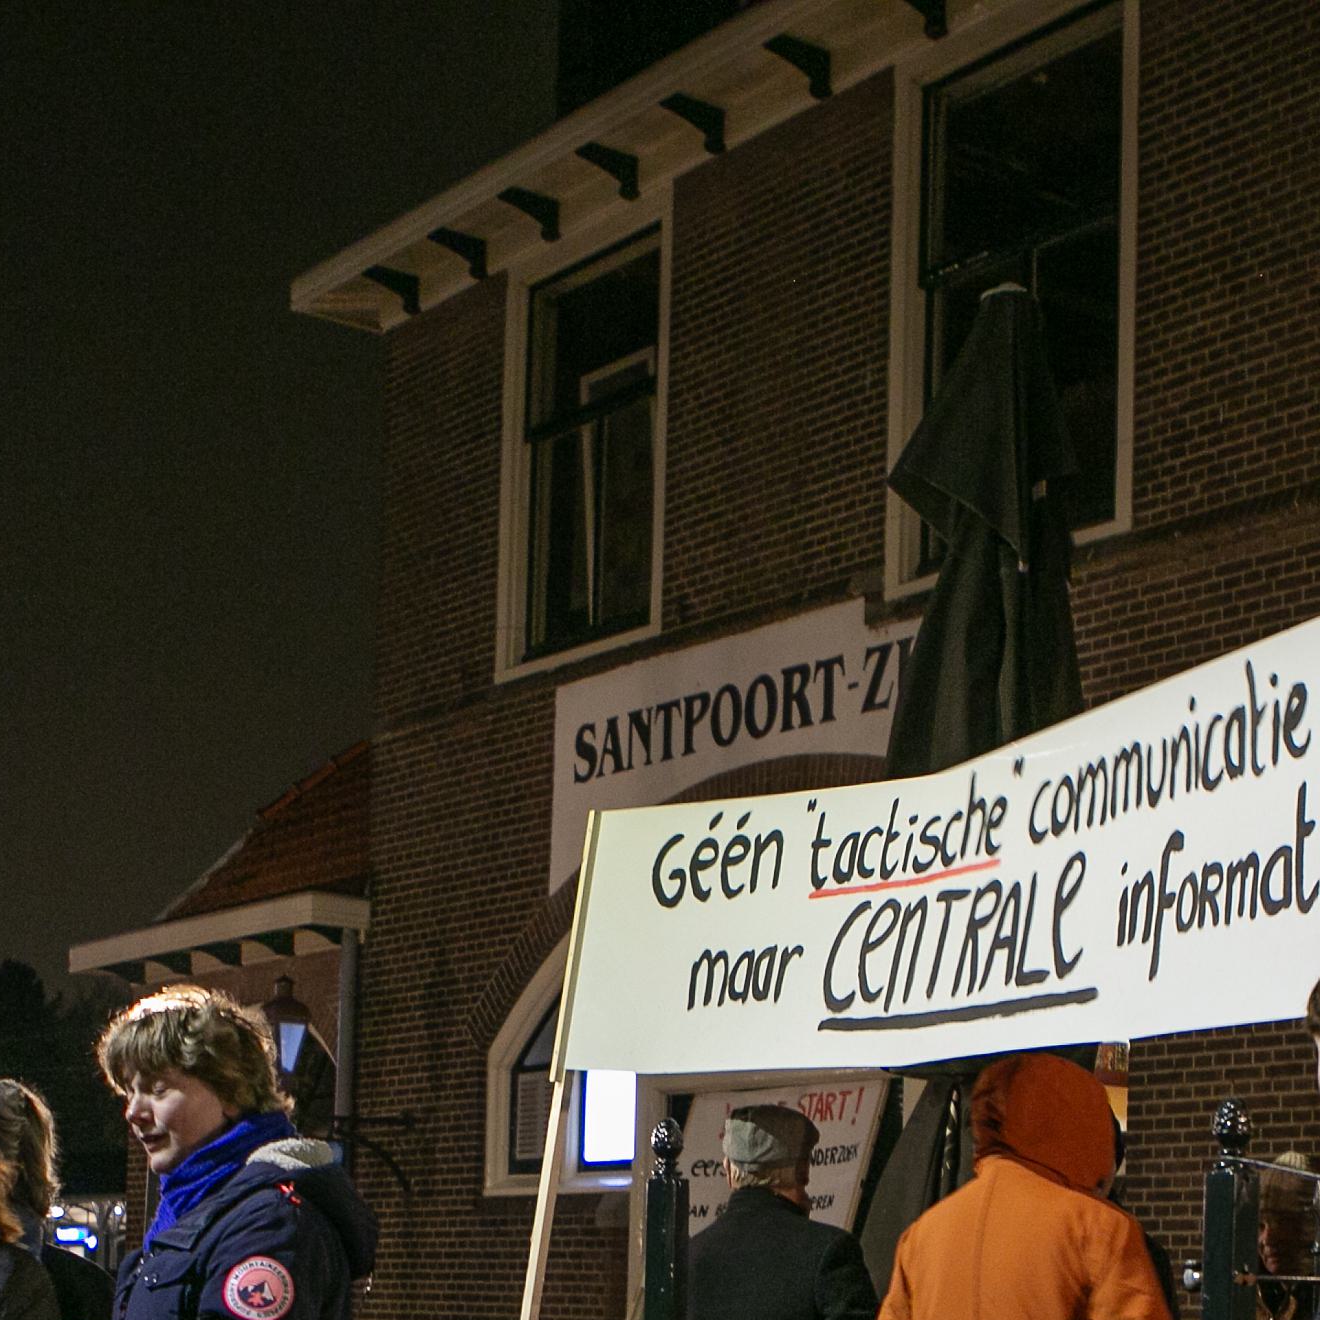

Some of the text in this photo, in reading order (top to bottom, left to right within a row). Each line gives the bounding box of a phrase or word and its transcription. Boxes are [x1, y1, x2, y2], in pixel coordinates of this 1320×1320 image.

[652, 811, 784, 908] Géén
[1029, 660, 1311, 844] communicatie
[687, 944, 804, 1011] maar
[809, 1143, 860, 1167] NDERZOEK
